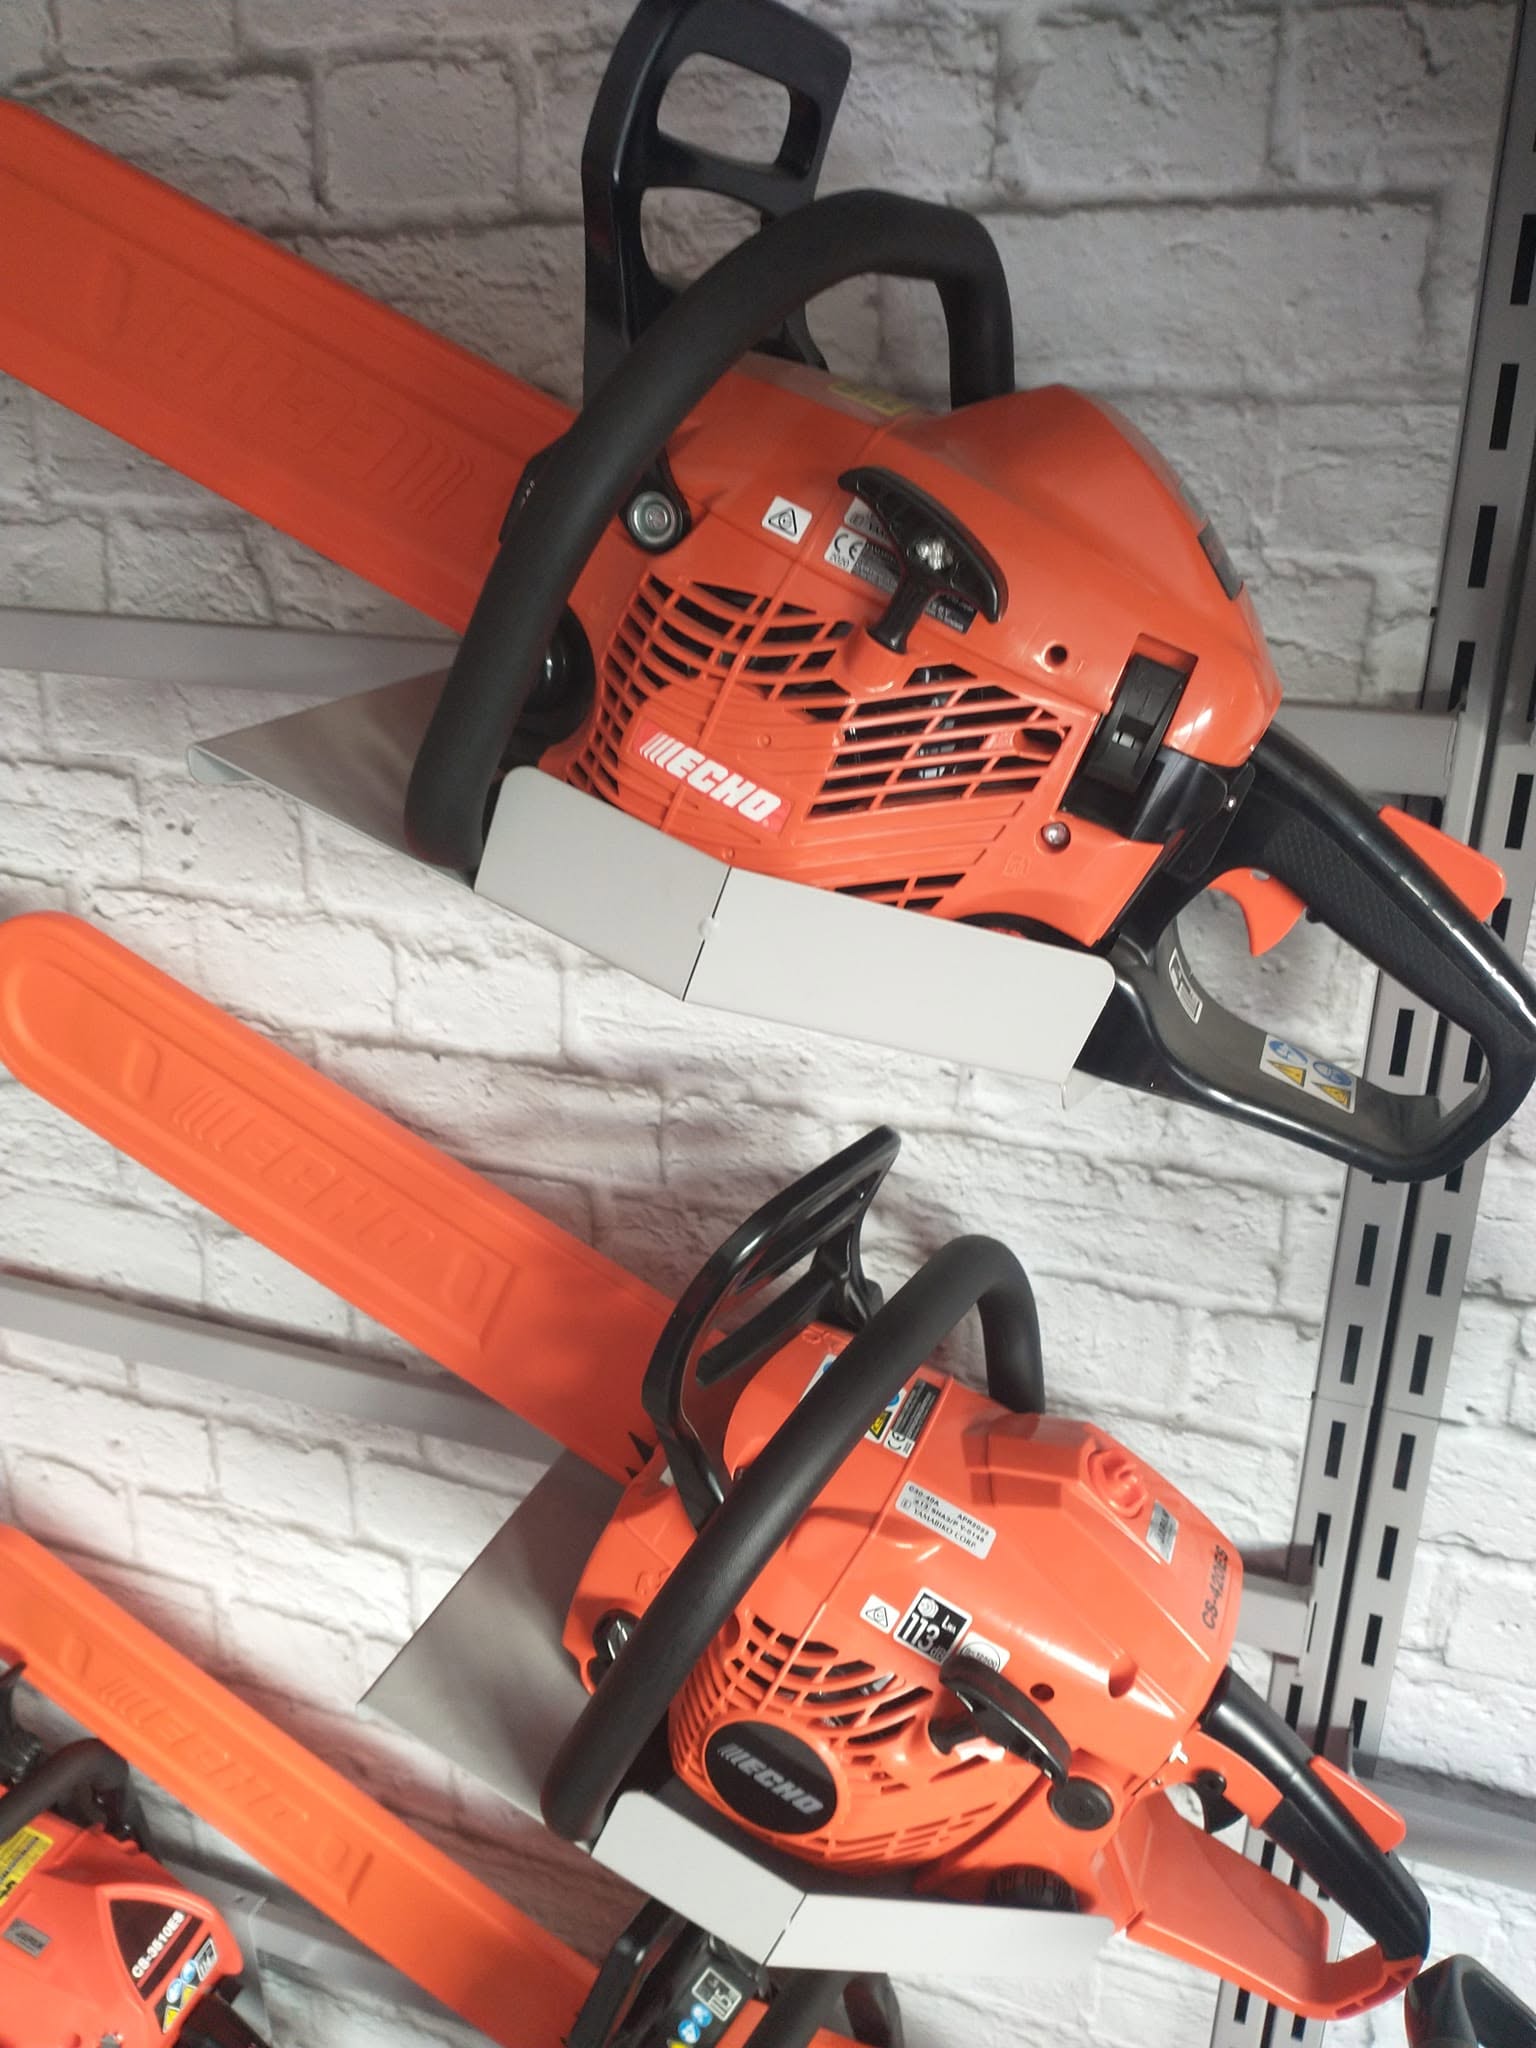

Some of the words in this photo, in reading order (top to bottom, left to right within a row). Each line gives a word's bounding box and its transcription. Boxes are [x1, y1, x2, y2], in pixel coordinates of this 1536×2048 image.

[660, 743, 782, 822] ECHO
[1201, 1544, 1229, 1630] CS-420ES
[901, 1612, 941, 1651] 113
[733, 1754, 824, 1814] ECHO
